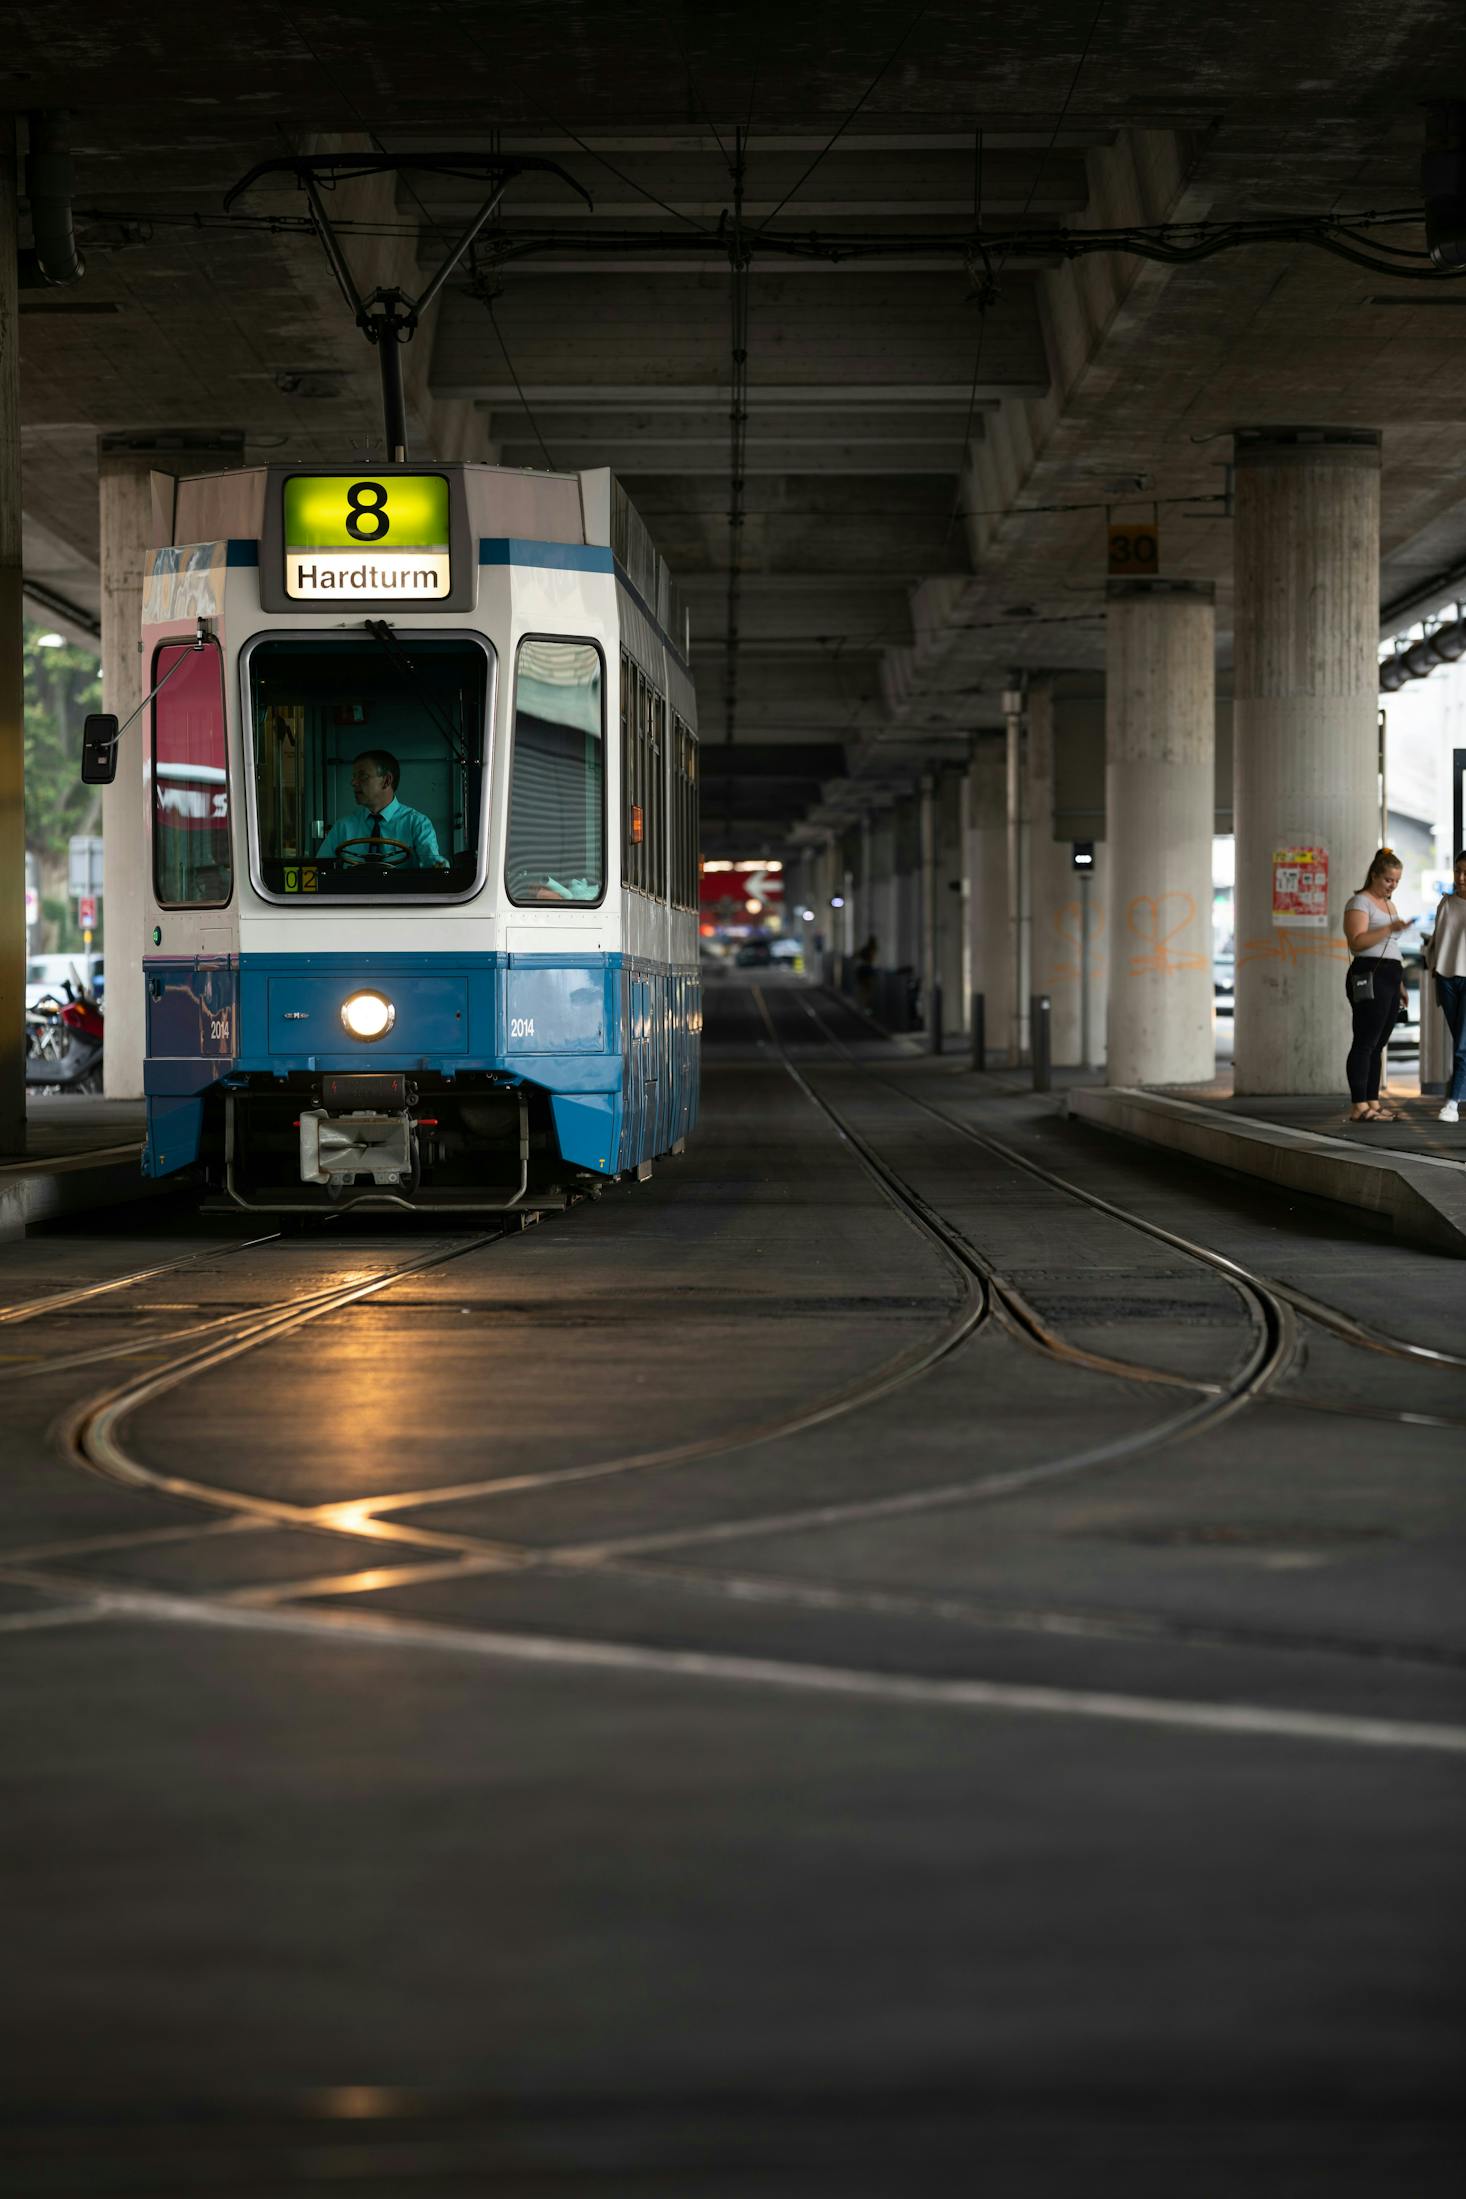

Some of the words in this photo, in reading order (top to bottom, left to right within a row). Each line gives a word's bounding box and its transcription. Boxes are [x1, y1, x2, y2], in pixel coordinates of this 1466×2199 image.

[345, 481, 390, 542] 8
[1109, 534, 1158, 564] 30
[297, 564, 438, 589] Hardturm
[210, 1020, 230, 1040] 2014
[510, 1018, 535, 1038] 2014
